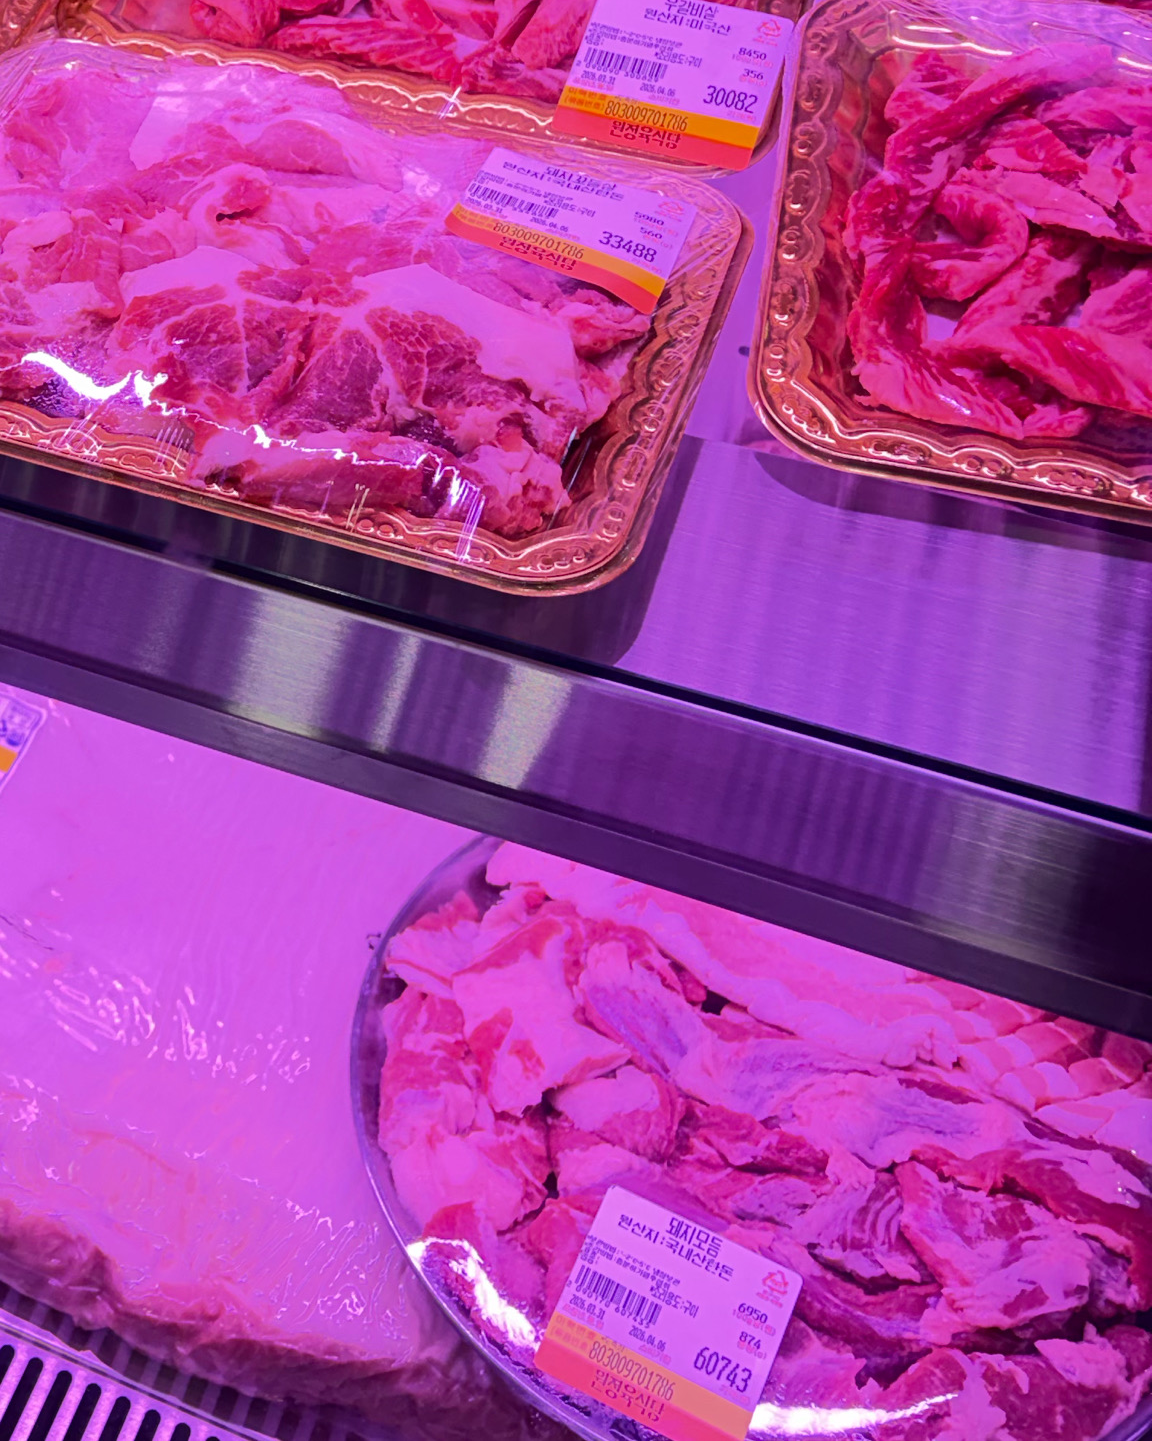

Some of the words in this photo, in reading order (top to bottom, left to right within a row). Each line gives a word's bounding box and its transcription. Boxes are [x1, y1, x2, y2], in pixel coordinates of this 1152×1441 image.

[643, 8, 732, 36] 원산지:미국산
[738, 46, 767, 61] 8450
[581, 70, 616, 85] 2026.03.31
[742, 67, 764, 81] 356
[639, 82, 676, 97] 2026.04.06
[703, 84, 758, 114] 30082
[604, 101, 689, 132] 803009701786
[609, 120, 681, 150] 원정육식당
[634, 211, 665, 226] 5980
[639, 226, 663, 240] 560
[493, 222, 585, 260] 803009701786
[499, 236, 577, 271] 원정육식당
[599, 231, 657, 264] 33488
[617, 1214, 734, 1283] 원산지:국내산한돈
[665, 1216, 724, 1259] 돼지모듬
[569, 1294, 605, 1320] 2026.03.31
[737, 1302, 769, 1324] 6950
[628, 1325, 667, 1352] 2026.04.06
[739, 1331, 762, 1350] 874
[588, 1340, 675, 1401] 803009701786
[693, 1346, 753, 1393] 60743
[591, 1370, 665, 1423] 원정육식당
